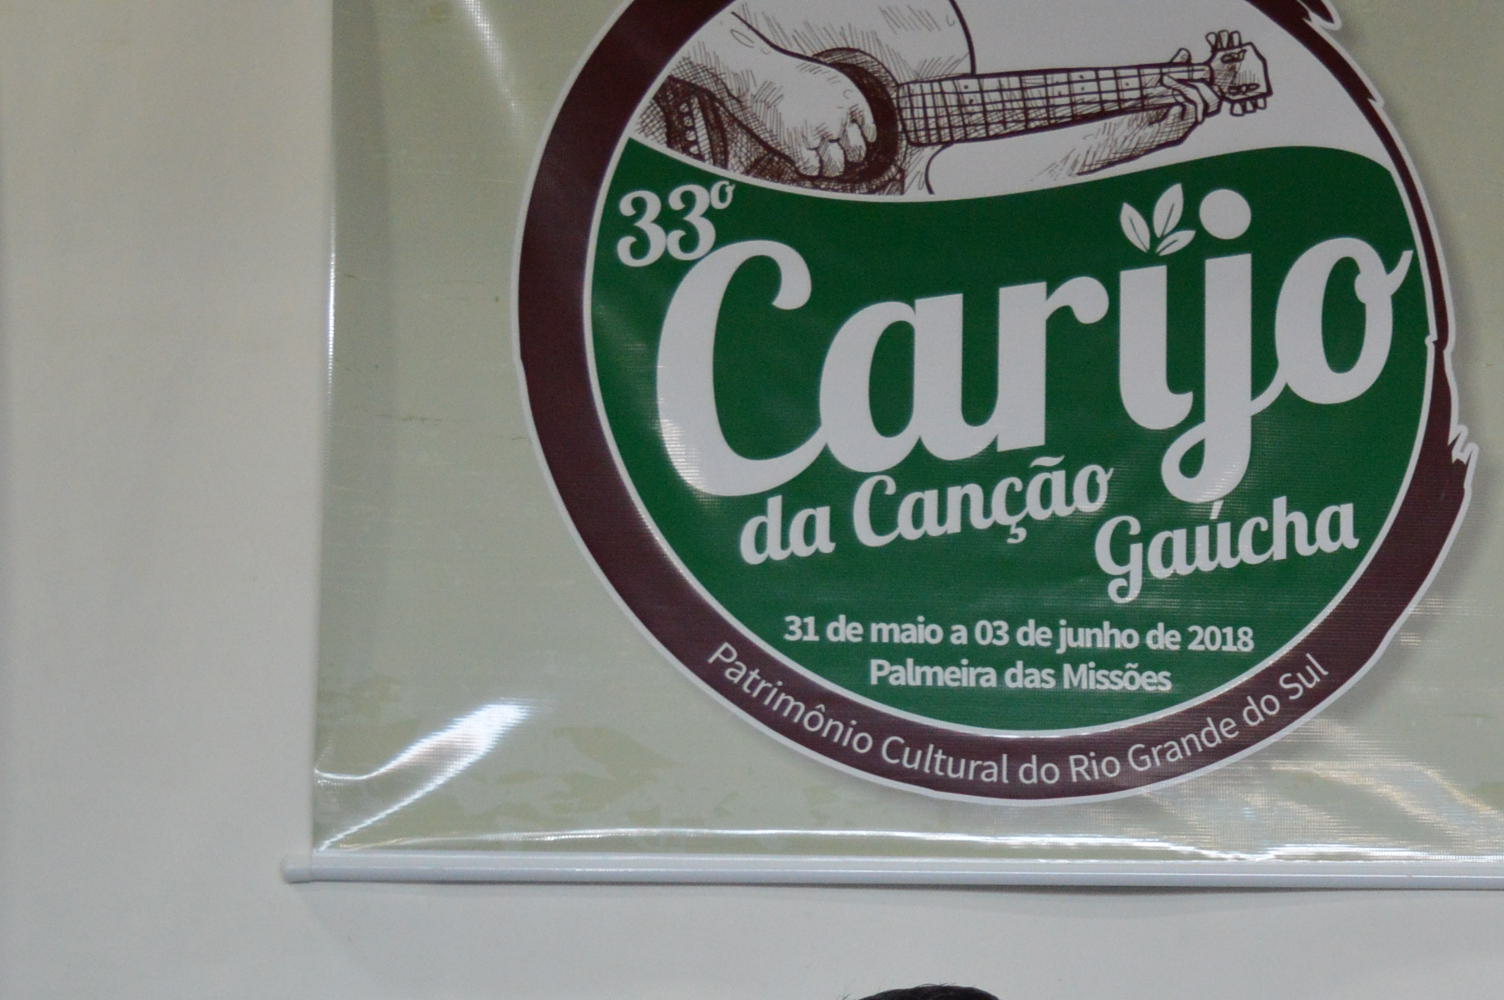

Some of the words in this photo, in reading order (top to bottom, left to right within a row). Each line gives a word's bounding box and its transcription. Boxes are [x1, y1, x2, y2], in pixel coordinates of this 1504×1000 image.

[656, 188, 1414, 504] Carijo
[740, 494, 836, 565] da
[852, 456, 1115, 548] Canção
[1094, 501, 1360, 604] Gaúcha
[784, 615, 820, 642] 31
[826, 614, 863, 643] de
[870, 616, 944, 645] maio
[950, 624, 968, 646] a
[975, 619, 1010, 648] 03
[1016, 618, 1053, 648] de
[1056, 619, 1140, 655] junho
[1146, 621, 1182, 652] de
[1187, 624, 1255, 653] 2018
[870, 657, 998, 688] Palmeira
[1004, 660, 1057, 690] das
[1063, 661, 1174, 694] Missões
[707, 641, 875, 755] Patrimônio
[881, 735, 1010, 785] Cultural
[1018, 754, 1061, 785] do
[1069, 751, 1122, 784] Rio
[1128, 716, 1240, 774] Grande
[1242, 695, 1282, 727] do
[1279, 652, 1330, 700] Sul
